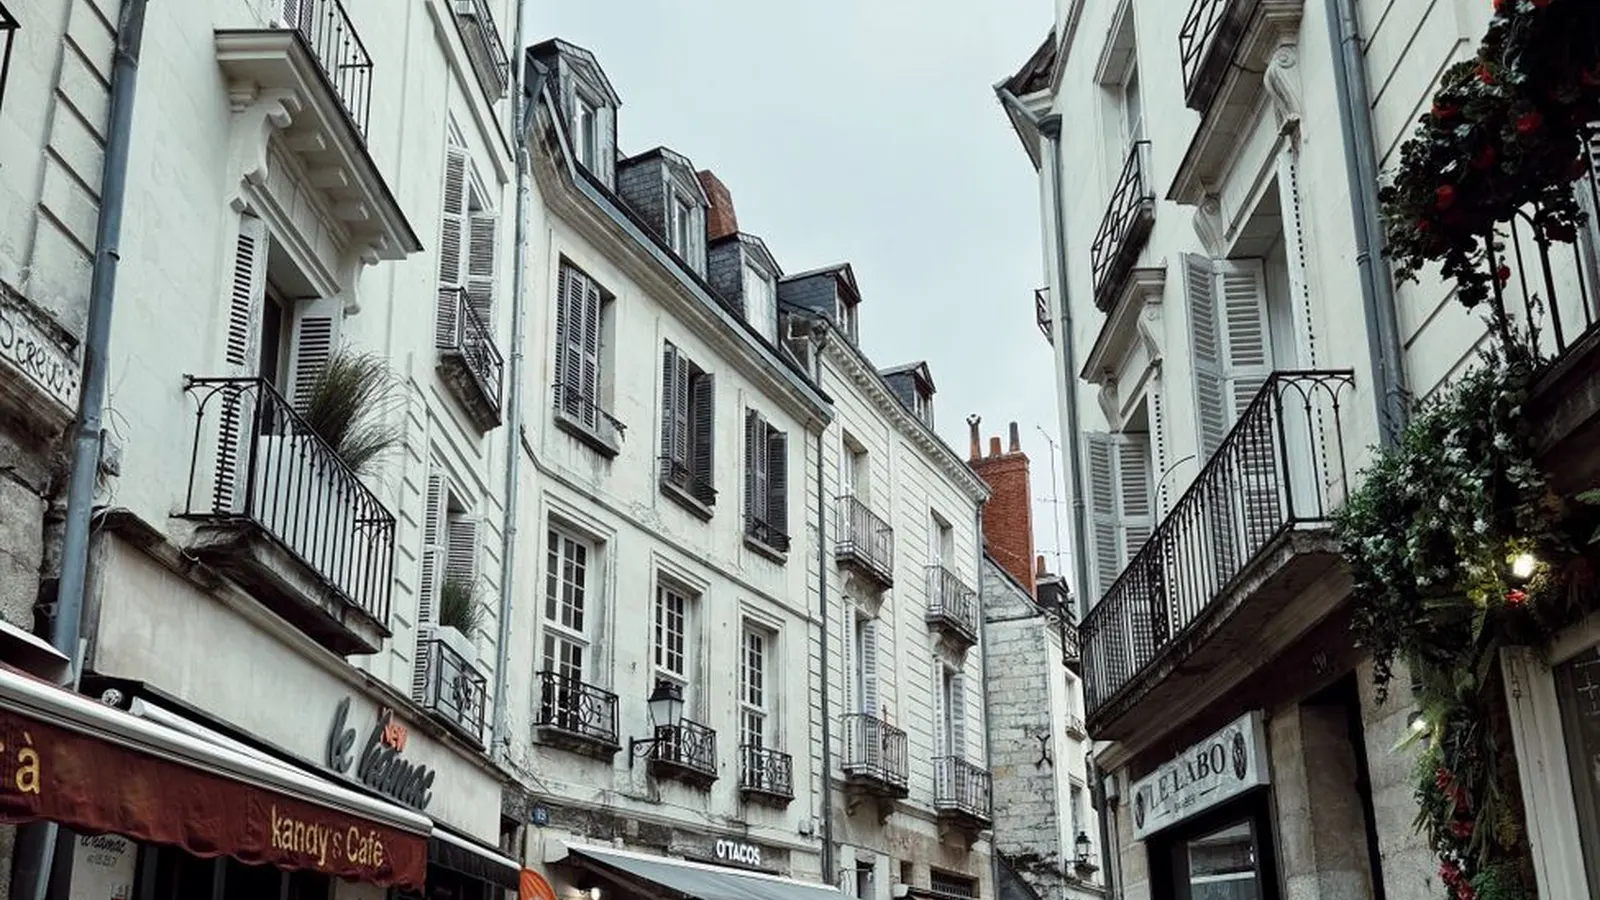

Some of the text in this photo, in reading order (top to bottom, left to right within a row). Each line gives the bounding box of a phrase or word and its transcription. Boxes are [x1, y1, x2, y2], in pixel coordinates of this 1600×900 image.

[16, 731, 40, 794] à
[1171, 743, 1226, 793] LABO
[346, 825, 384, 867] Café
